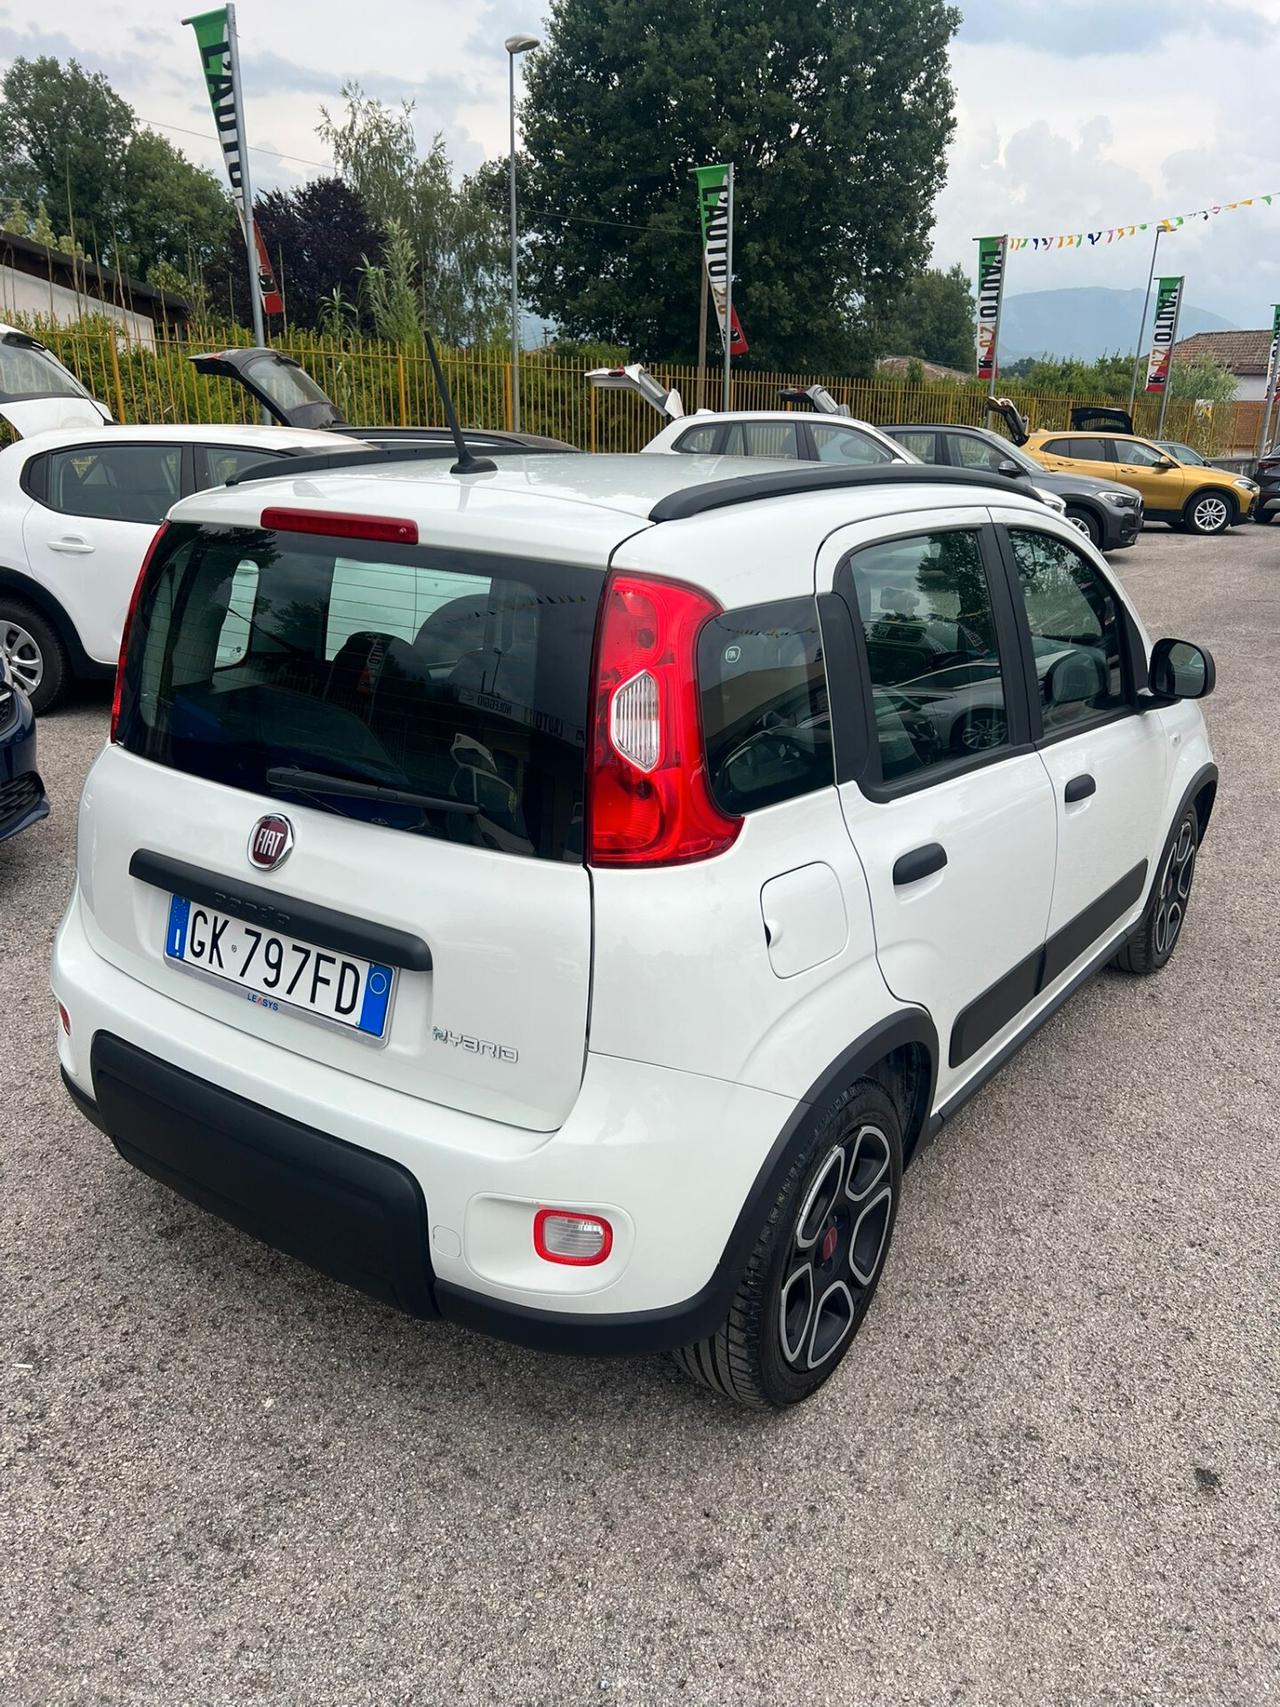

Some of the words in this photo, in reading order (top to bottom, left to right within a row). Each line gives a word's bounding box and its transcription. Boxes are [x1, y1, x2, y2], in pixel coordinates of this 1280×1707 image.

[980, 250, 1002, 318] L'AUTO
[1153, 288, 1178, 342] L'AUTO
[254, 827, 285, 857] FIAT
[189, 909, 230, 969] GK
[239, 927, 361, 1015] 797FD
[247, 992, 279, 1011] LEASYS
